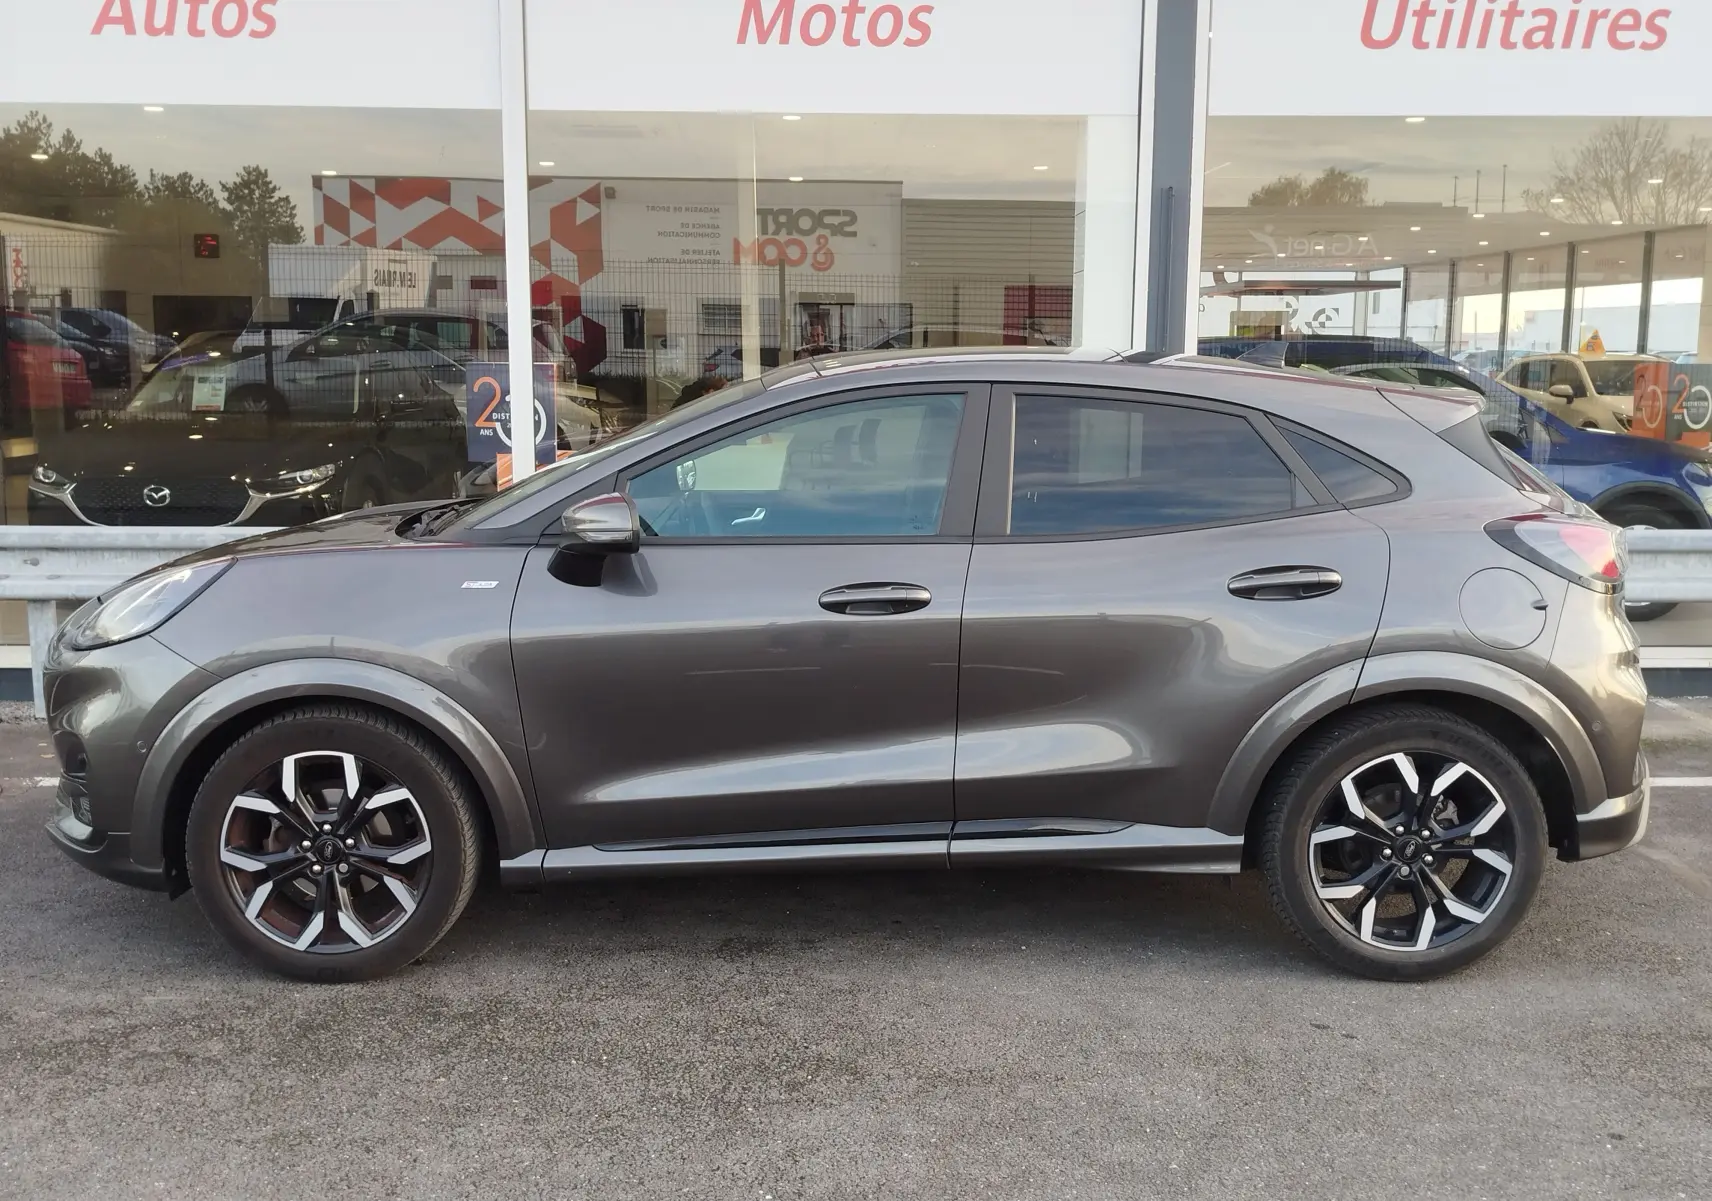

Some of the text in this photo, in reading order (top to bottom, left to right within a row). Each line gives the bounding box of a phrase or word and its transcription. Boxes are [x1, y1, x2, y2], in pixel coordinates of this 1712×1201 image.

[90, 0, 278, 39] Autos
[736, 0, 934, 48] Motos
[1360, 0, 1671, 51] Utilitaires
